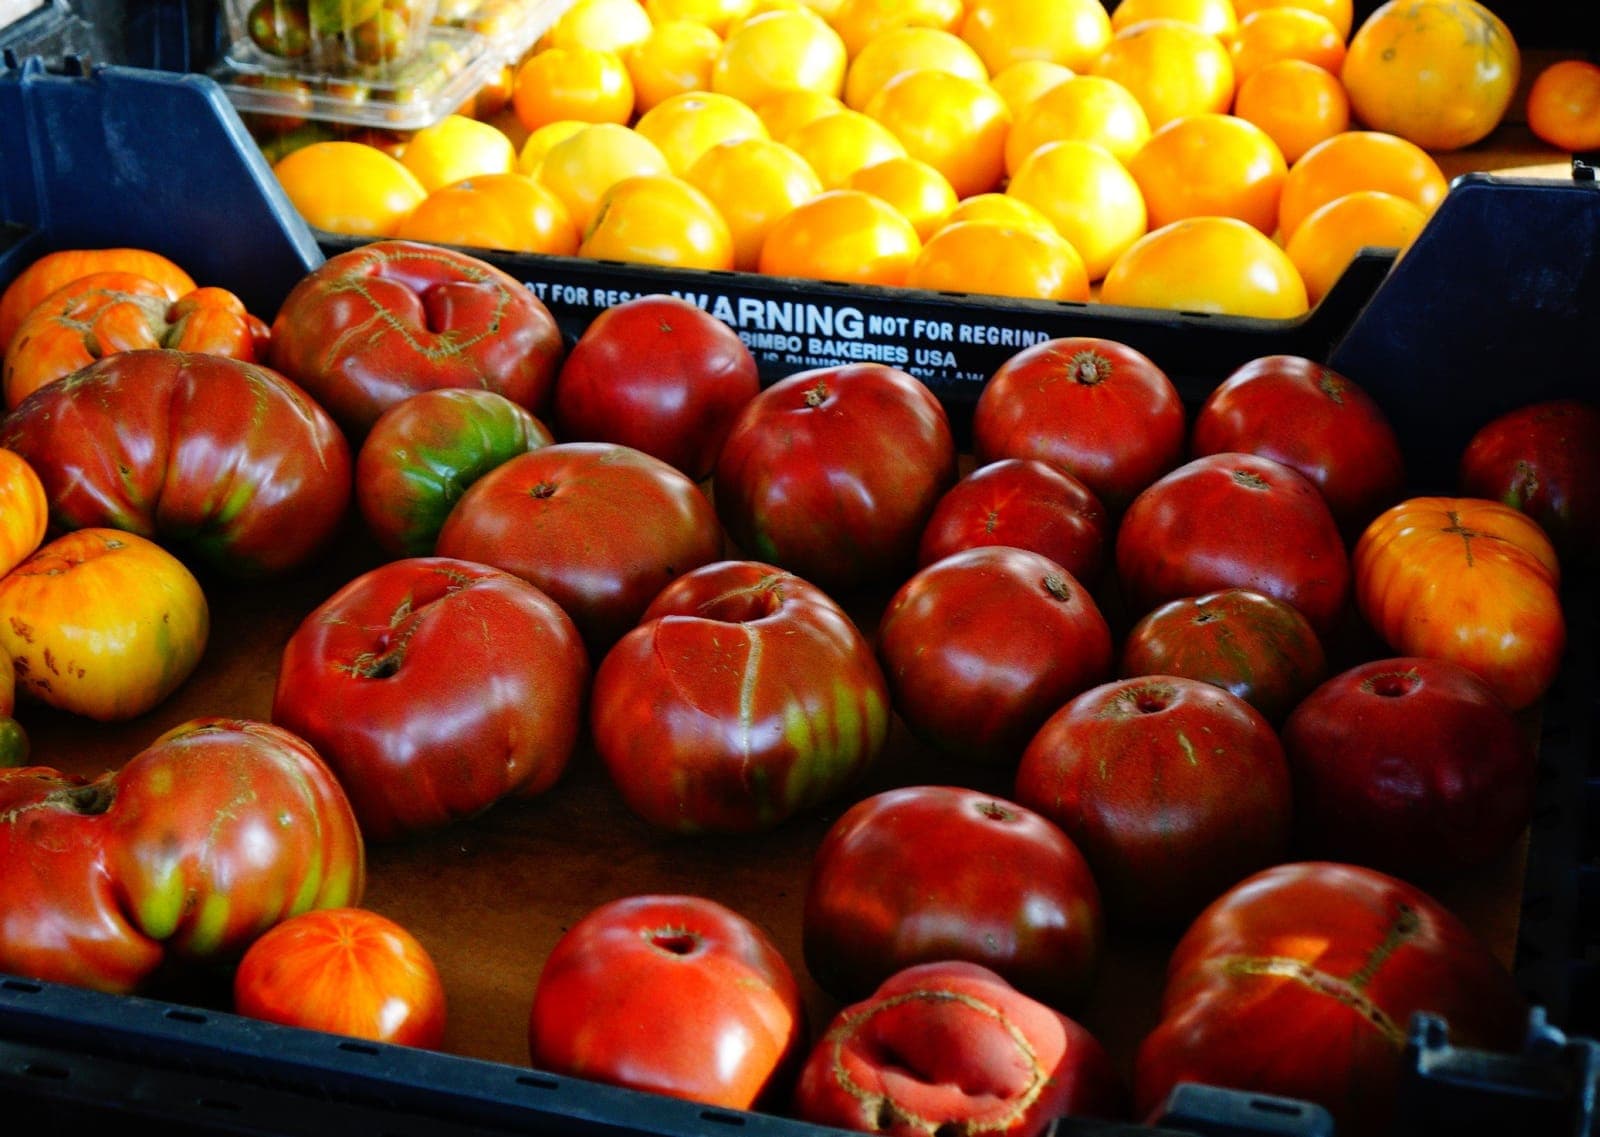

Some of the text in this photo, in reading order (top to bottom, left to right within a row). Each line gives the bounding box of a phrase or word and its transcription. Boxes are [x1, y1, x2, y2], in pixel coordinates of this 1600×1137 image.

[552, 283, 590, 306] FOR
[869, 314, 910, 337] NOT
[913, 319, 954, 342] FOR
[959, 323, 1051, 348] REGRIND
[739, 331, 959, 369] BIMBO BAKERIES USA
